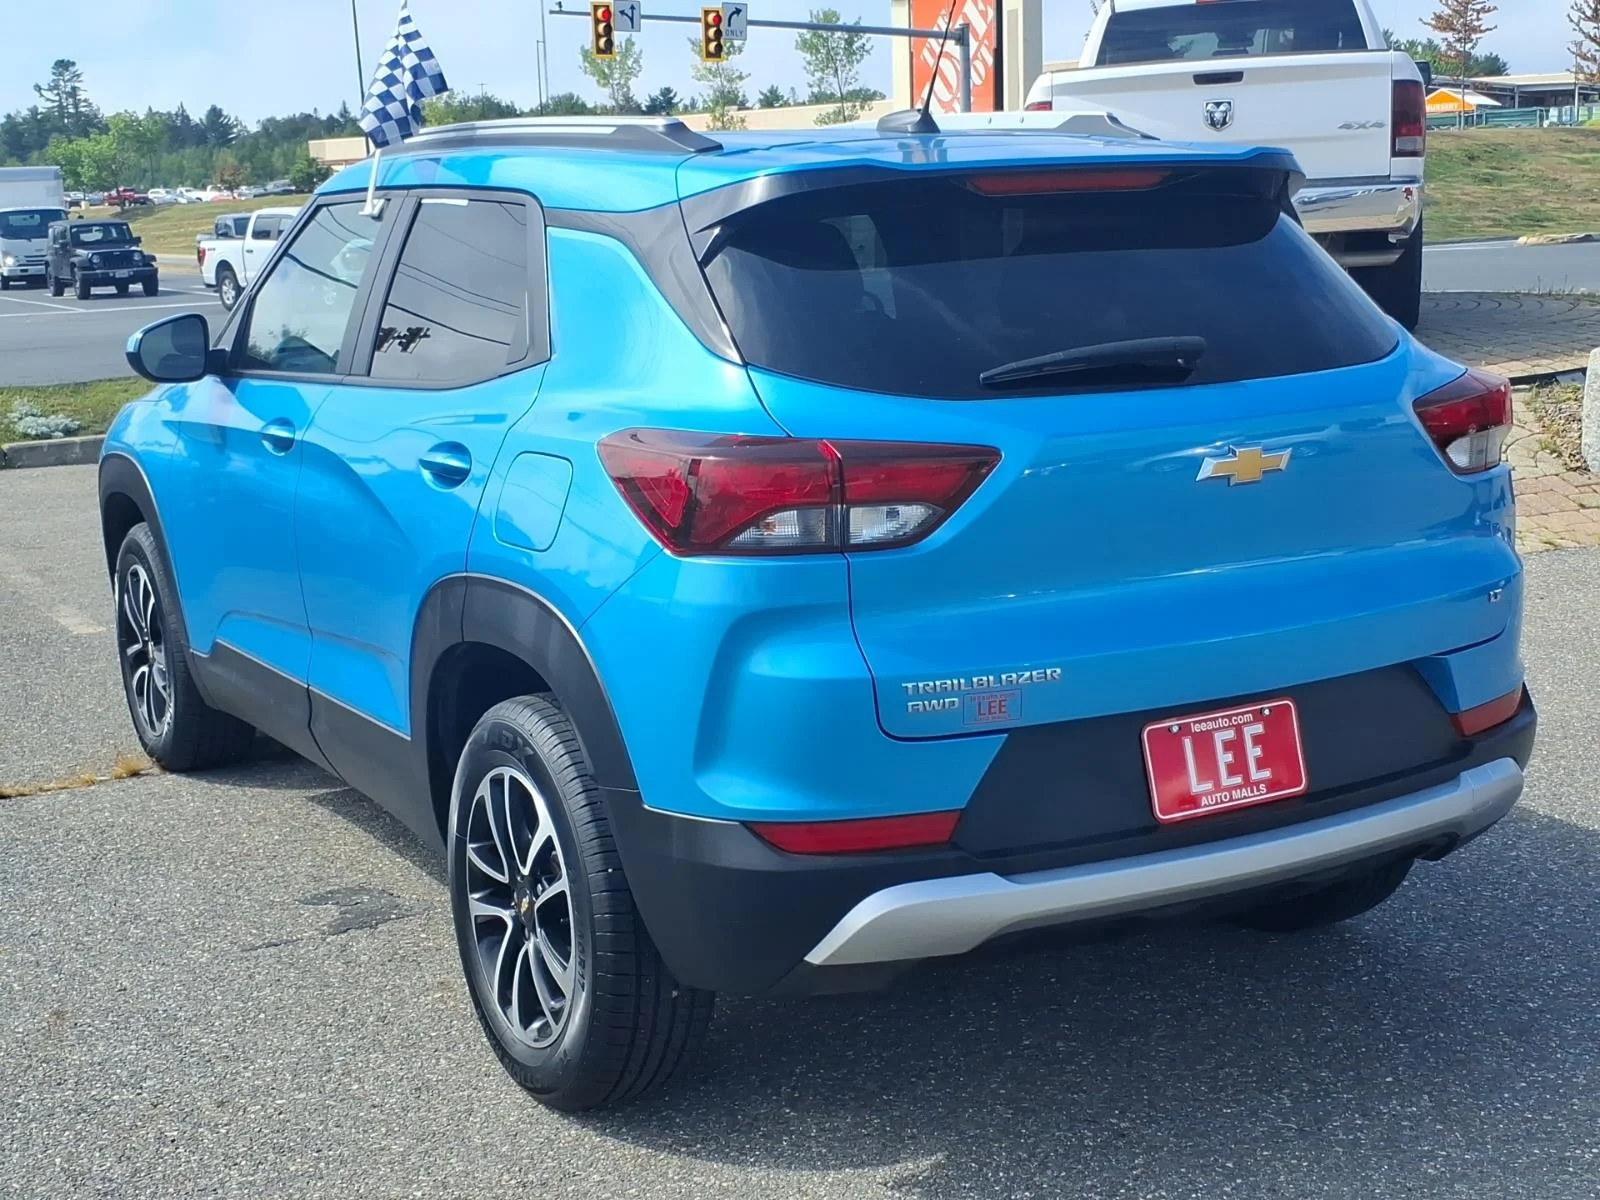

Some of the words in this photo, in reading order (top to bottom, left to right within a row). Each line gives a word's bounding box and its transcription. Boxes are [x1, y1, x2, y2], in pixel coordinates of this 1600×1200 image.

[724, 29, 744, 38] ONLY
[902, 667, 1062, 696] TRAILBLAZER
[907, 697, 959, 713] AWD
[977, 699, 1007, 716] LEE
[1190, 711, 1254, 734] leeauto.com
[1182, 722, 1272, 795] LEE
[1200, 790, 1230, 807] AUTO
[1231, 783, 1267, 802] MALLS
